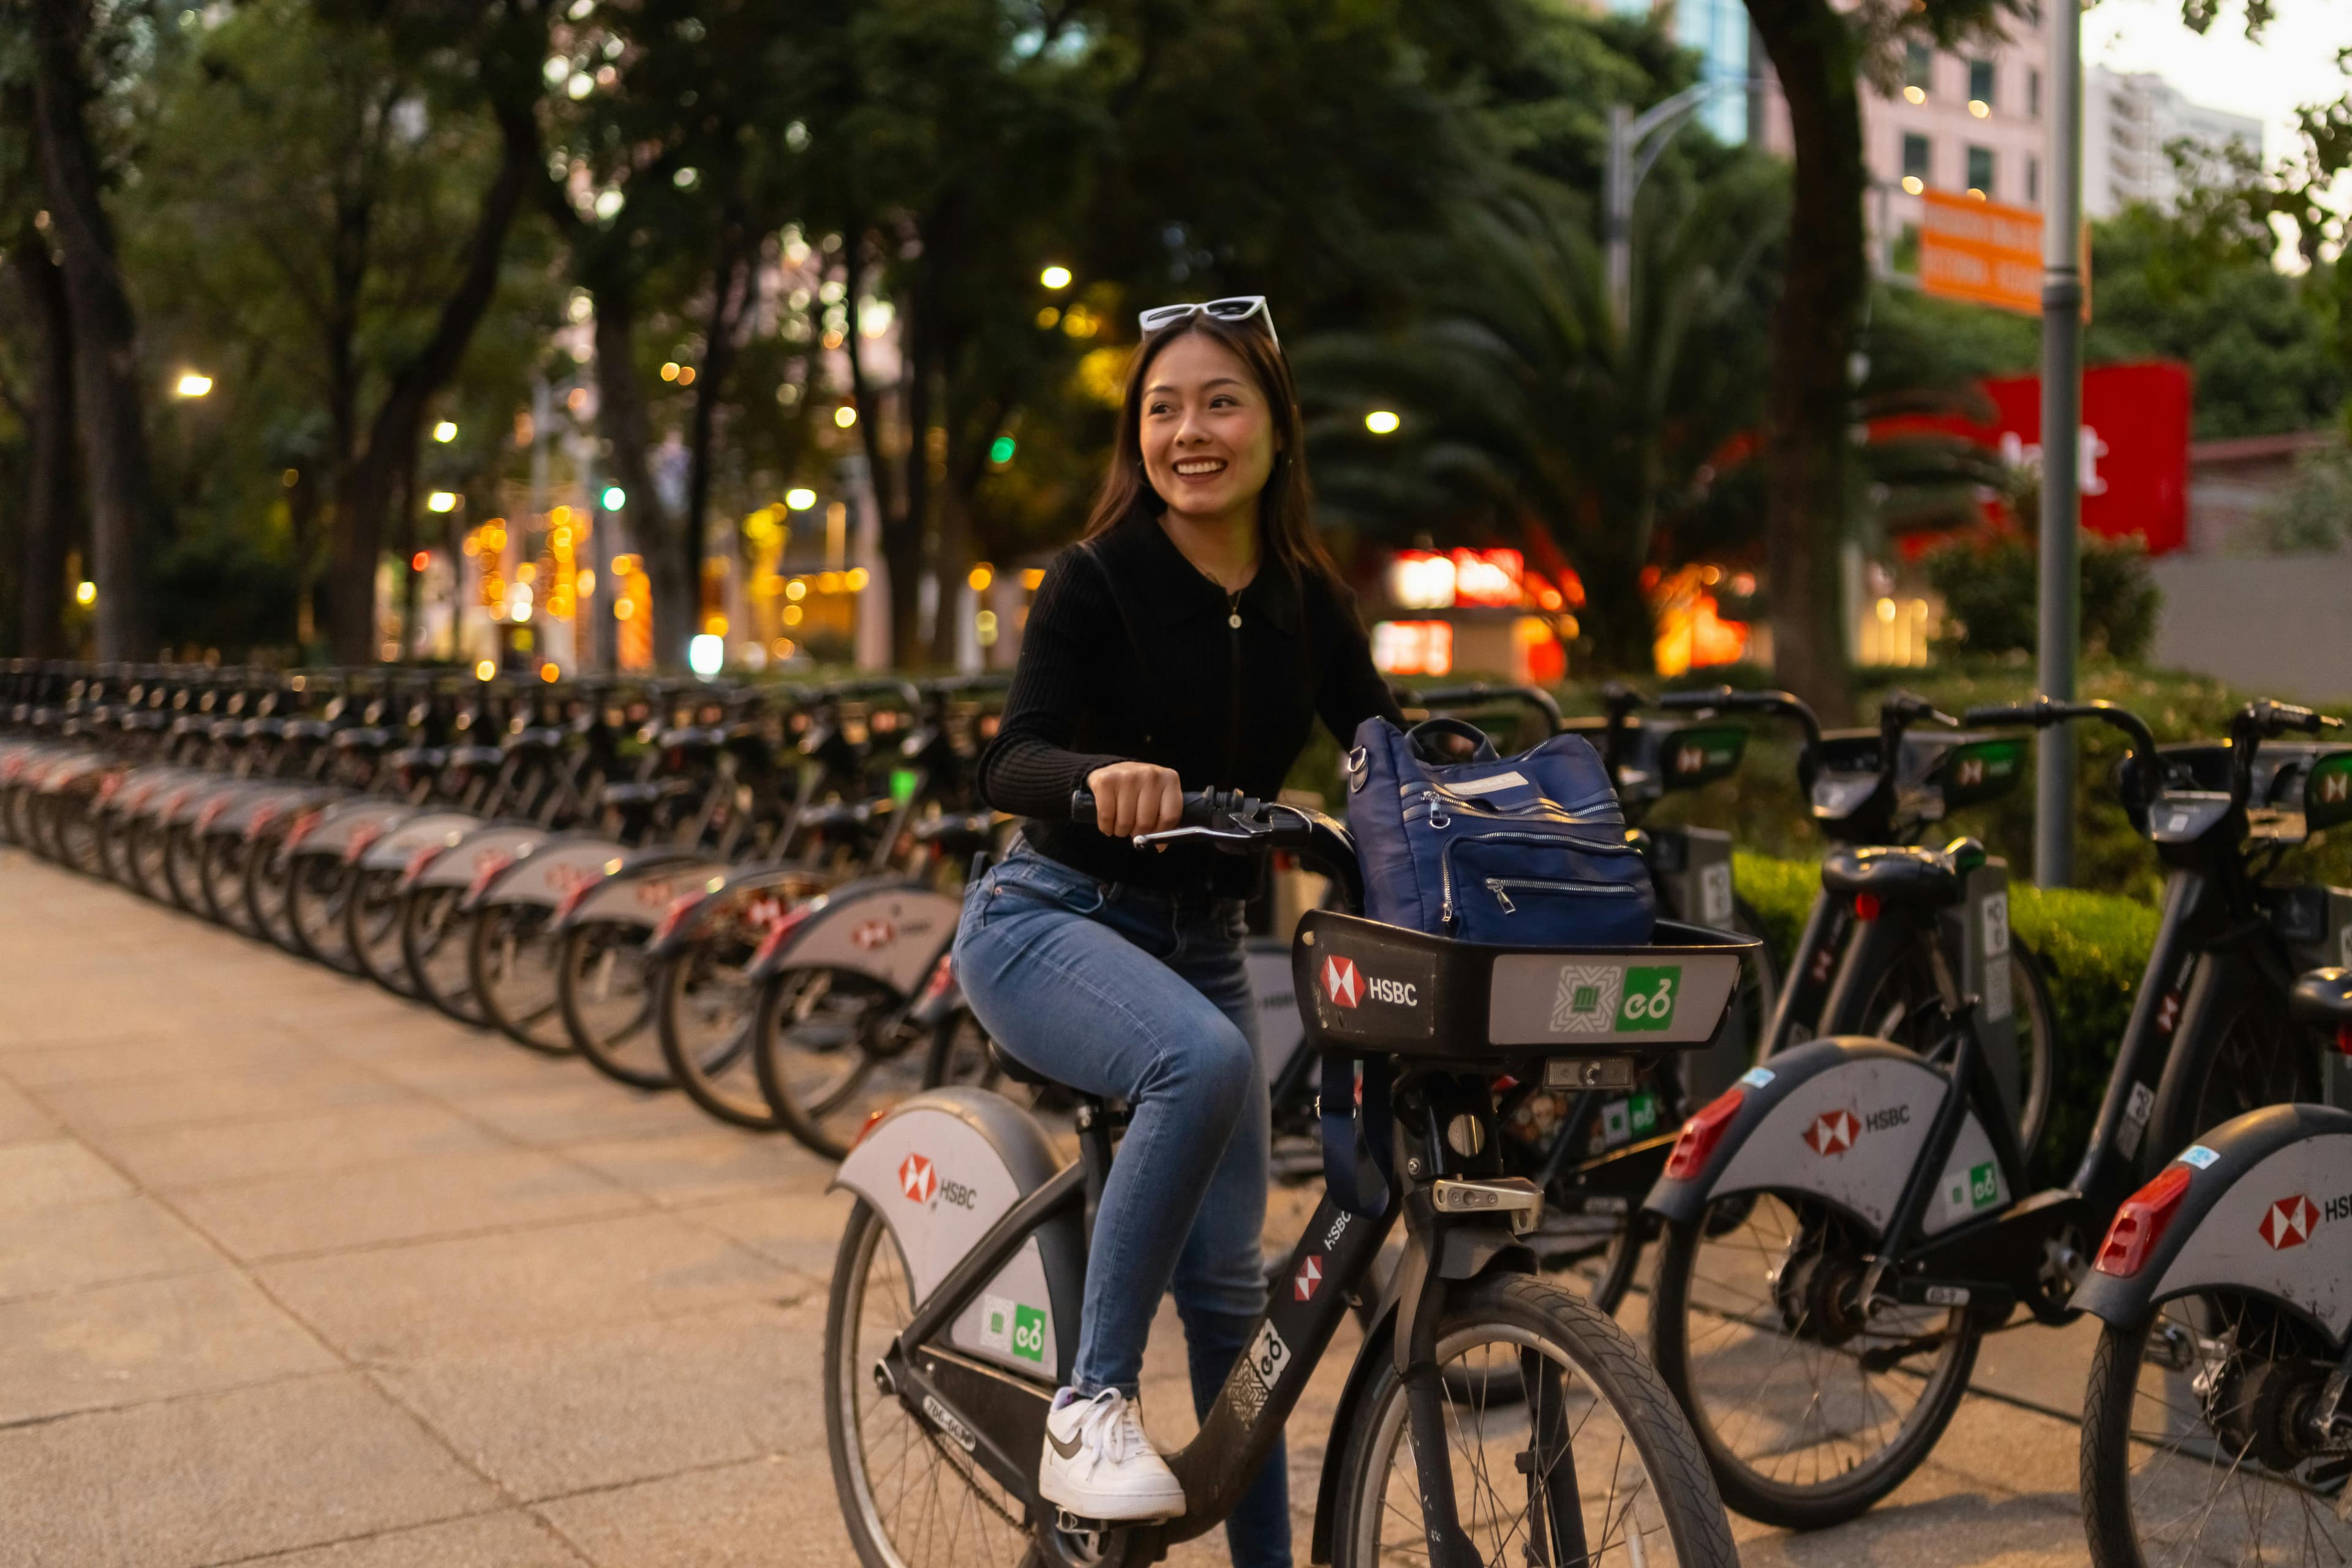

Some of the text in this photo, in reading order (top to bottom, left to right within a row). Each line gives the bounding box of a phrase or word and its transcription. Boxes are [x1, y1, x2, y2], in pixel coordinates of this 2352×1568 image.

[1370, 977, 1417, 1006] HSBC
[1866, 1104, 1910, 1133] HSBC
[940, 1178, 977, 1210] HSBC
[2325, 1194, 2352, 1223] HS
